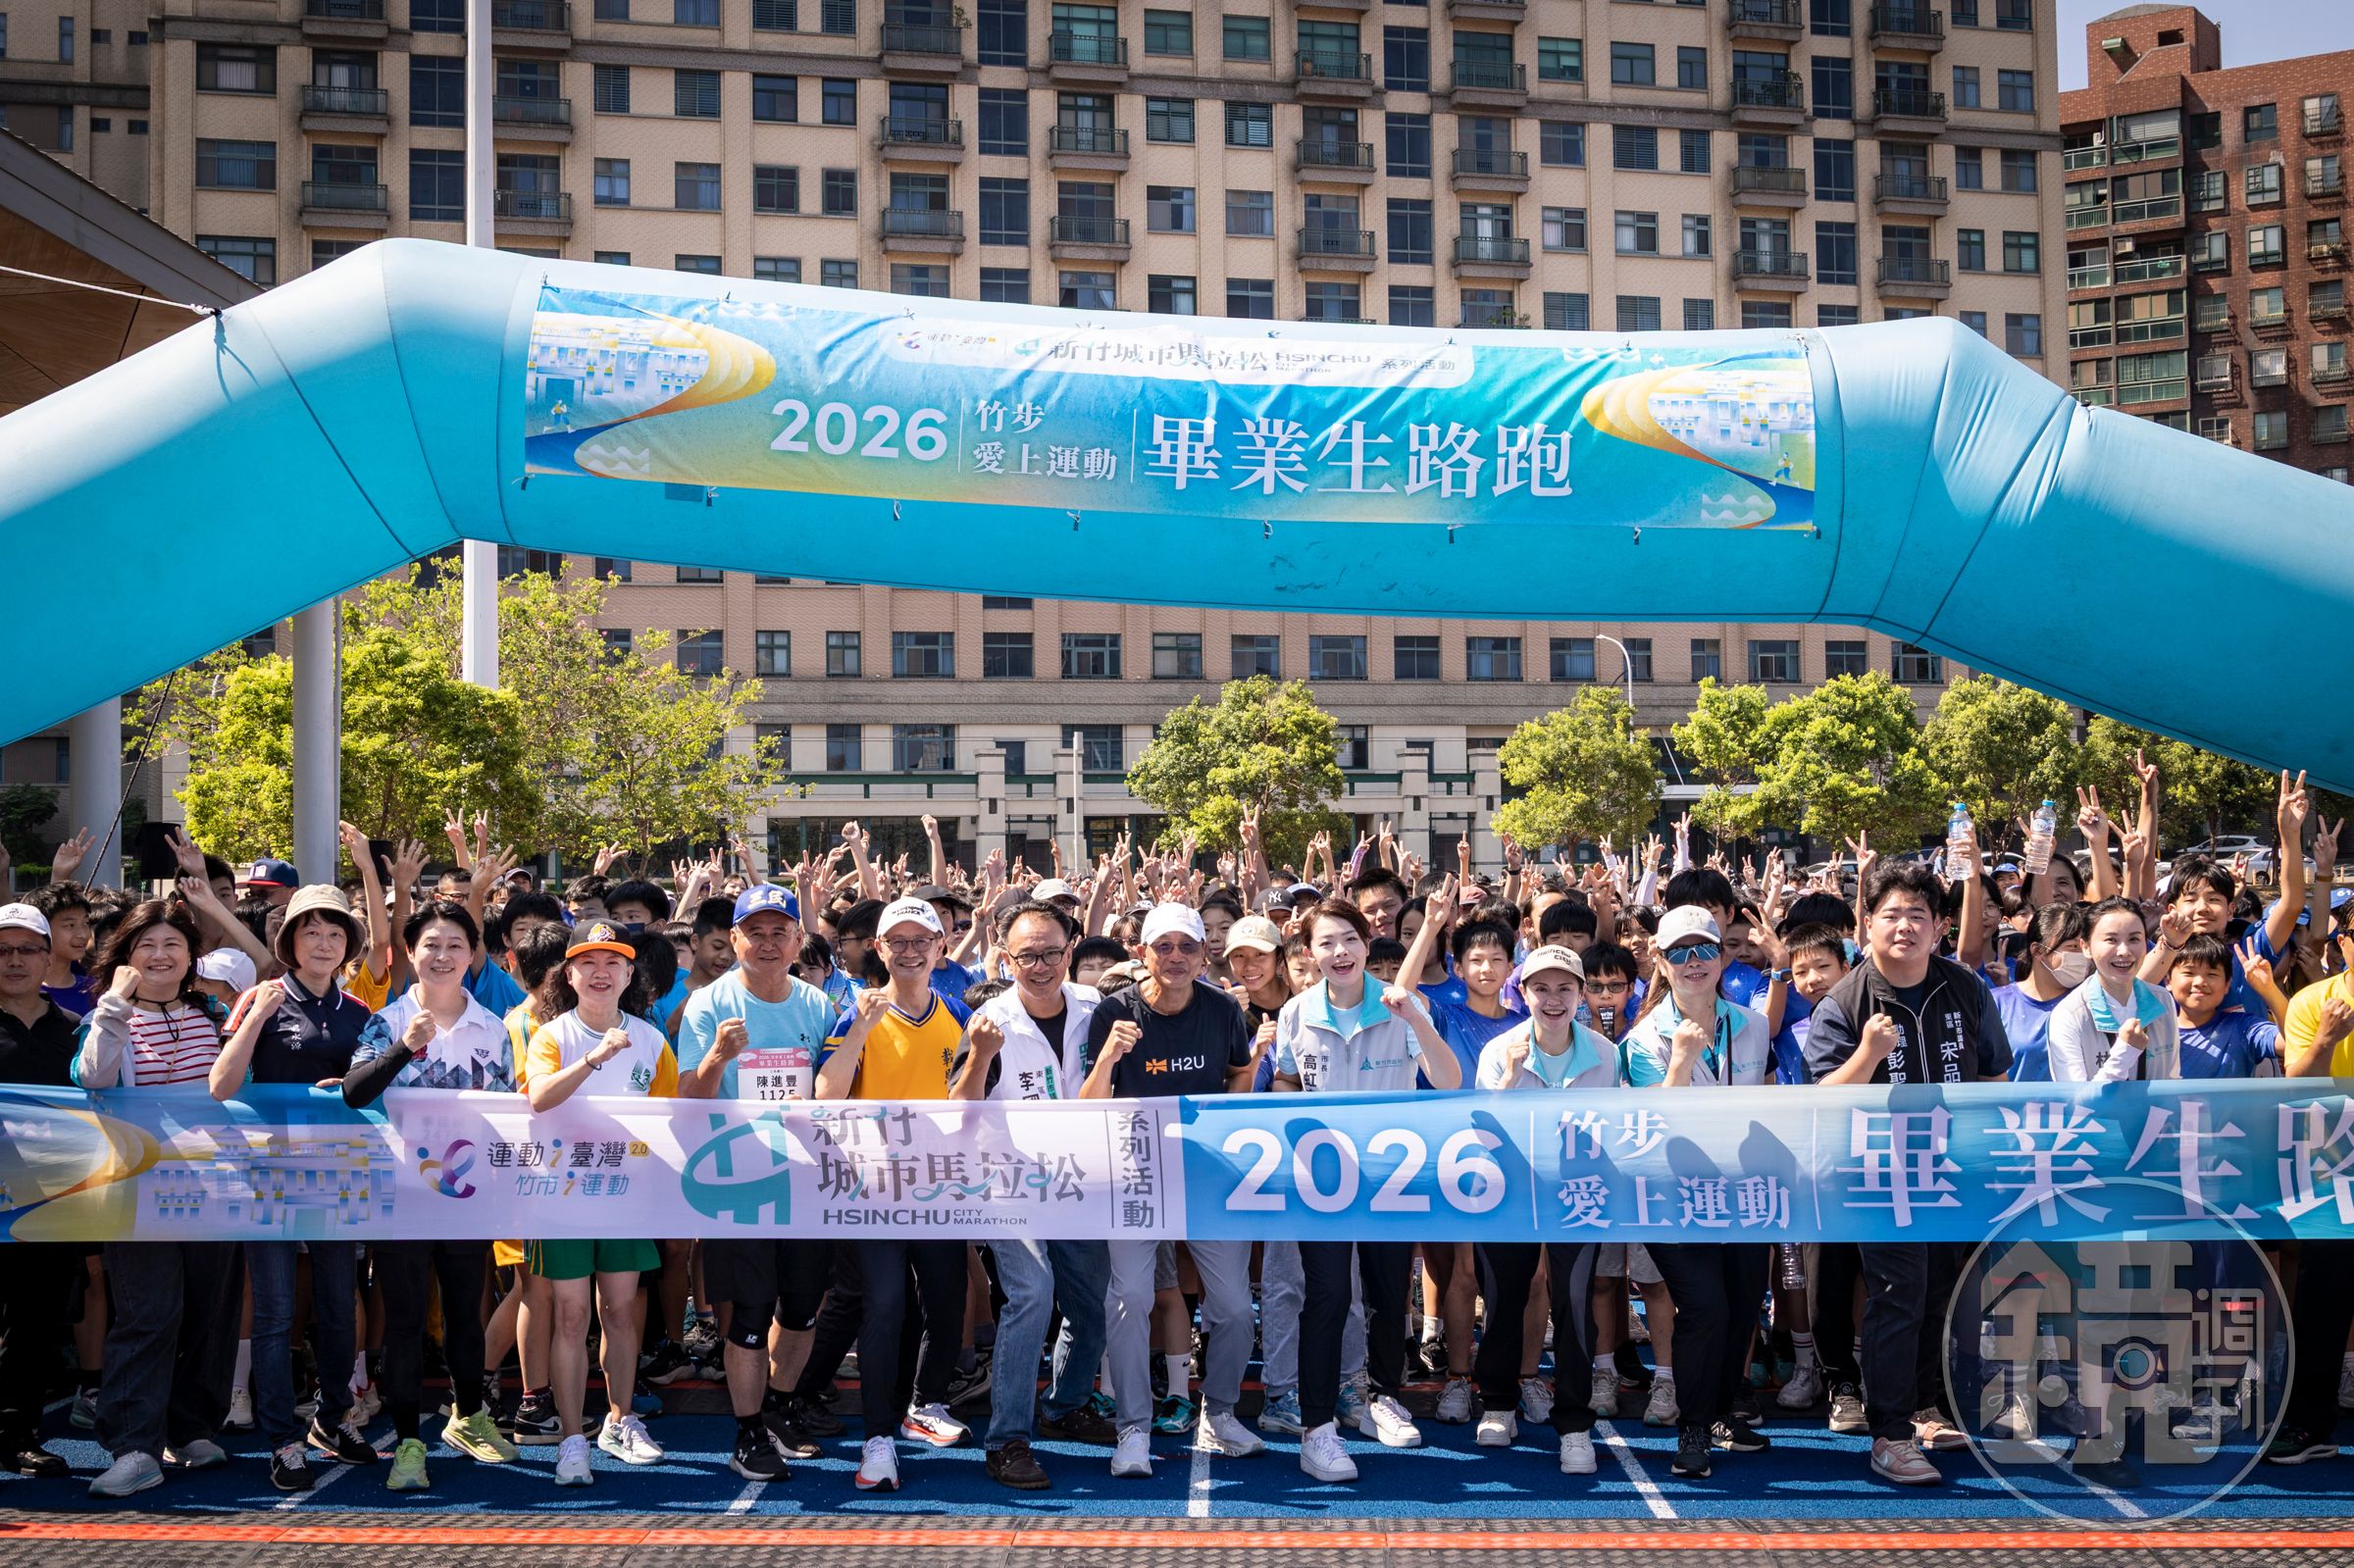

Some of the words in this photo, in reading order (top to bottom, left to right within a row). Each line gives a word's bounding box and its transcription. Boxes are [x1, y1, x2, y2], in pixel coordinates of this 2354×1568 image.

[1276, 352, 1371, 364] HSINCHU
[1381, 358, 1456, 371] 系列活動
[770, 398, 947, 461] 2026
[974, 400, 1046, 433] 竹步
[973, 441, 1117, 481] 愛上運動
[1143, 414, 1573, 499] 畢業生路跑
[756, 1075, 797, 1088] 陳進豐
[1171, 1055, 1204, 1072] H2U
[810, 1106, 917, 1146] 新竹
[1555, 1109, 1670, 1160] 竹步
[631, 1143, 648, 1155] 2.0
[1835, 1100, 2354, 1229] 畢業生路
[816, 1151, 1088, 1202] 城市馬拉松
[1117, 1110, 1154, 1230] 系列活動
[1223, 1128, 1507, 1214] 2026
[823, 1208, 950, 1225] HSINCHU
[1557, 1175, 1791, 1230] 愛上運動
